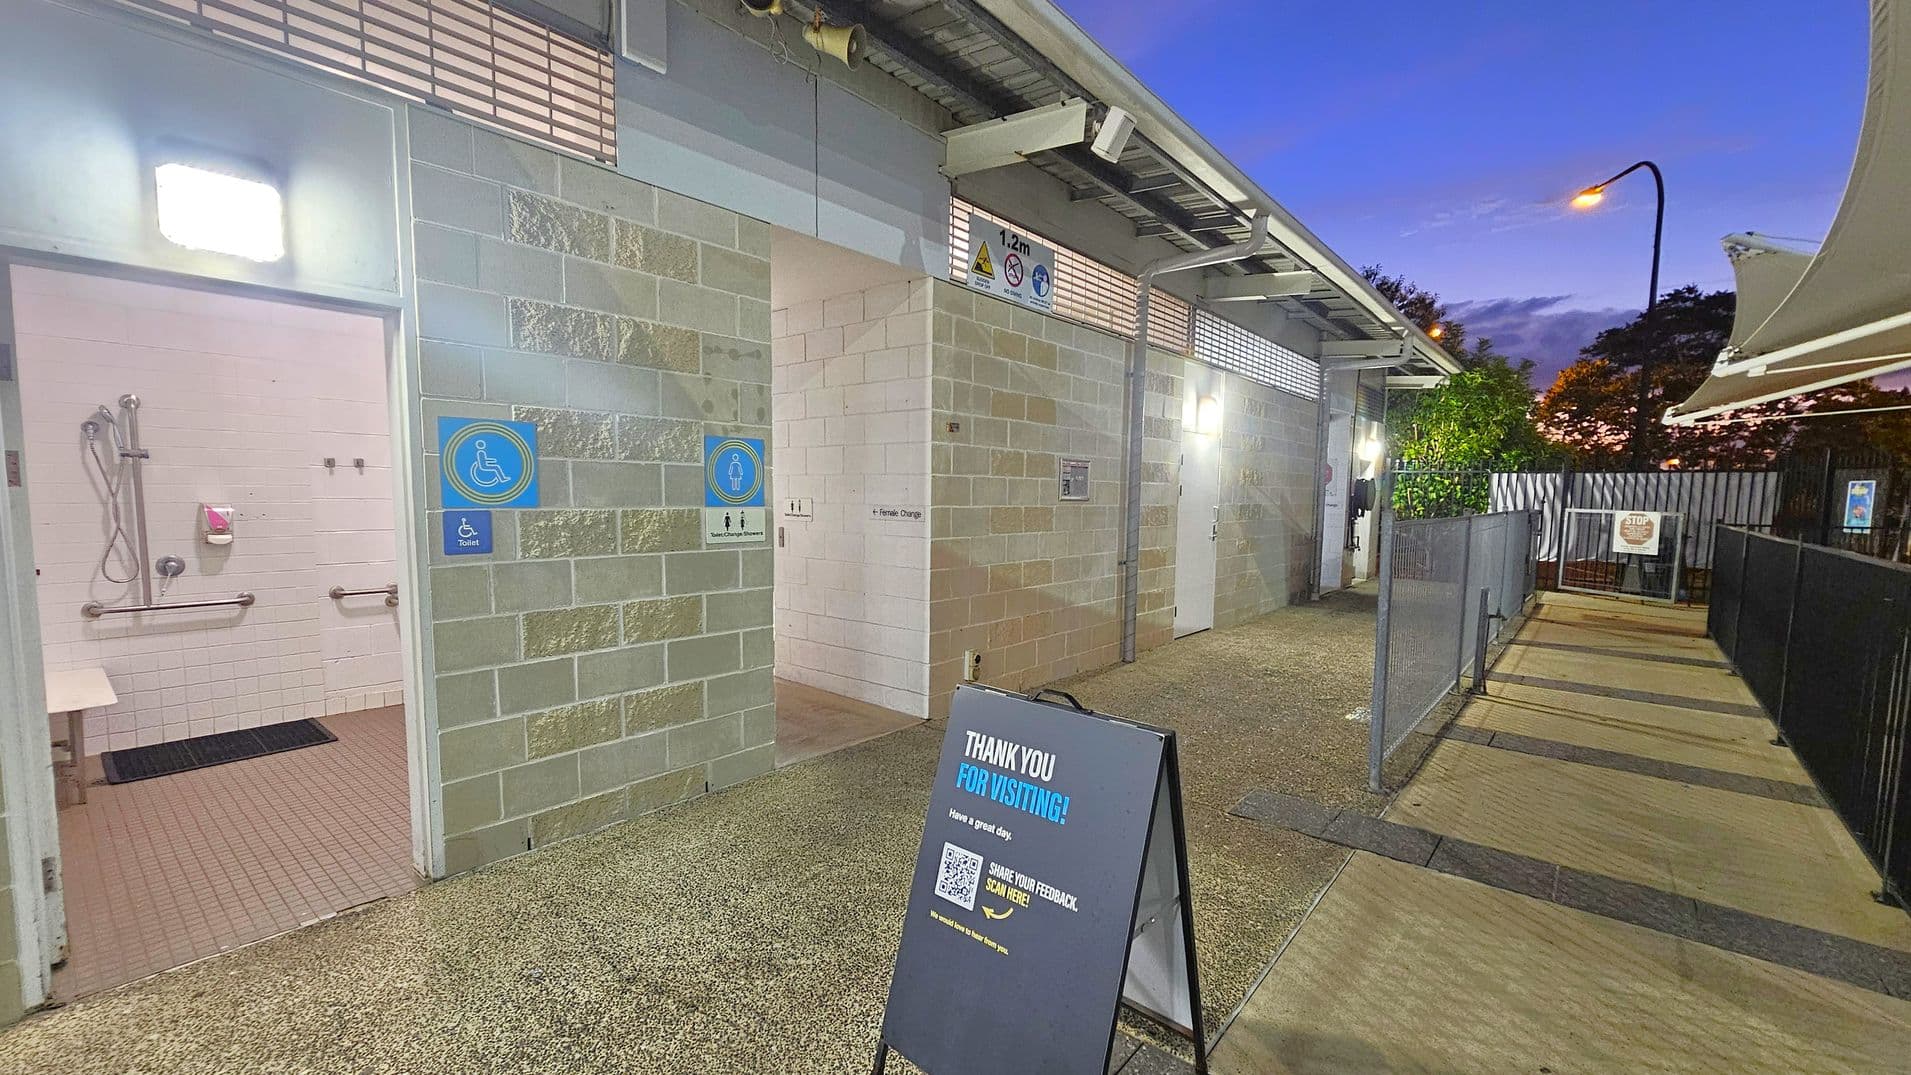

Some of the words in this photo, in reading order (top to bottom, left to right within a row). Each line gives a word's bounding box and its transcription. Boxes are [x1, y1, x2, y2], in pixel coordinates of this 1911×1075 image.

[1000, 230, 1030, 256] 1.2m
[879, 508, 898, 517] Female
[900, 509, 921, 520] Change
[1626, 516, 1649, 525] STOP
[965, 730, 1020, 771] THANK
[1020, 745, 1056, 782] YOU
[956, 762, 989, 797] FOR
[990, 772, 1070, 825] VISITING!
[949, 808, 969, 823] Have
[968, 817, 974, 826] a
[974, 820, 996, 834] great
[995, 826, 1012, 841] day.
[985, 878, 1007, 899] SCAN
[1006, 885, 1031, 908] HERE!
[989, 862, 1015, 884] SHARE
[1014, 872, 1036, 893] YOUR
[1034, 881, 1078, 912] FEEDBACK.
[930, 909, 939, 920] We
[953, 921, 966, 933] love
[965, 927, 972, 936] to
[971, 930, 985, 943] hear
[983, 936, 998, 949] from
[996, 944, 1009, 956] you.
